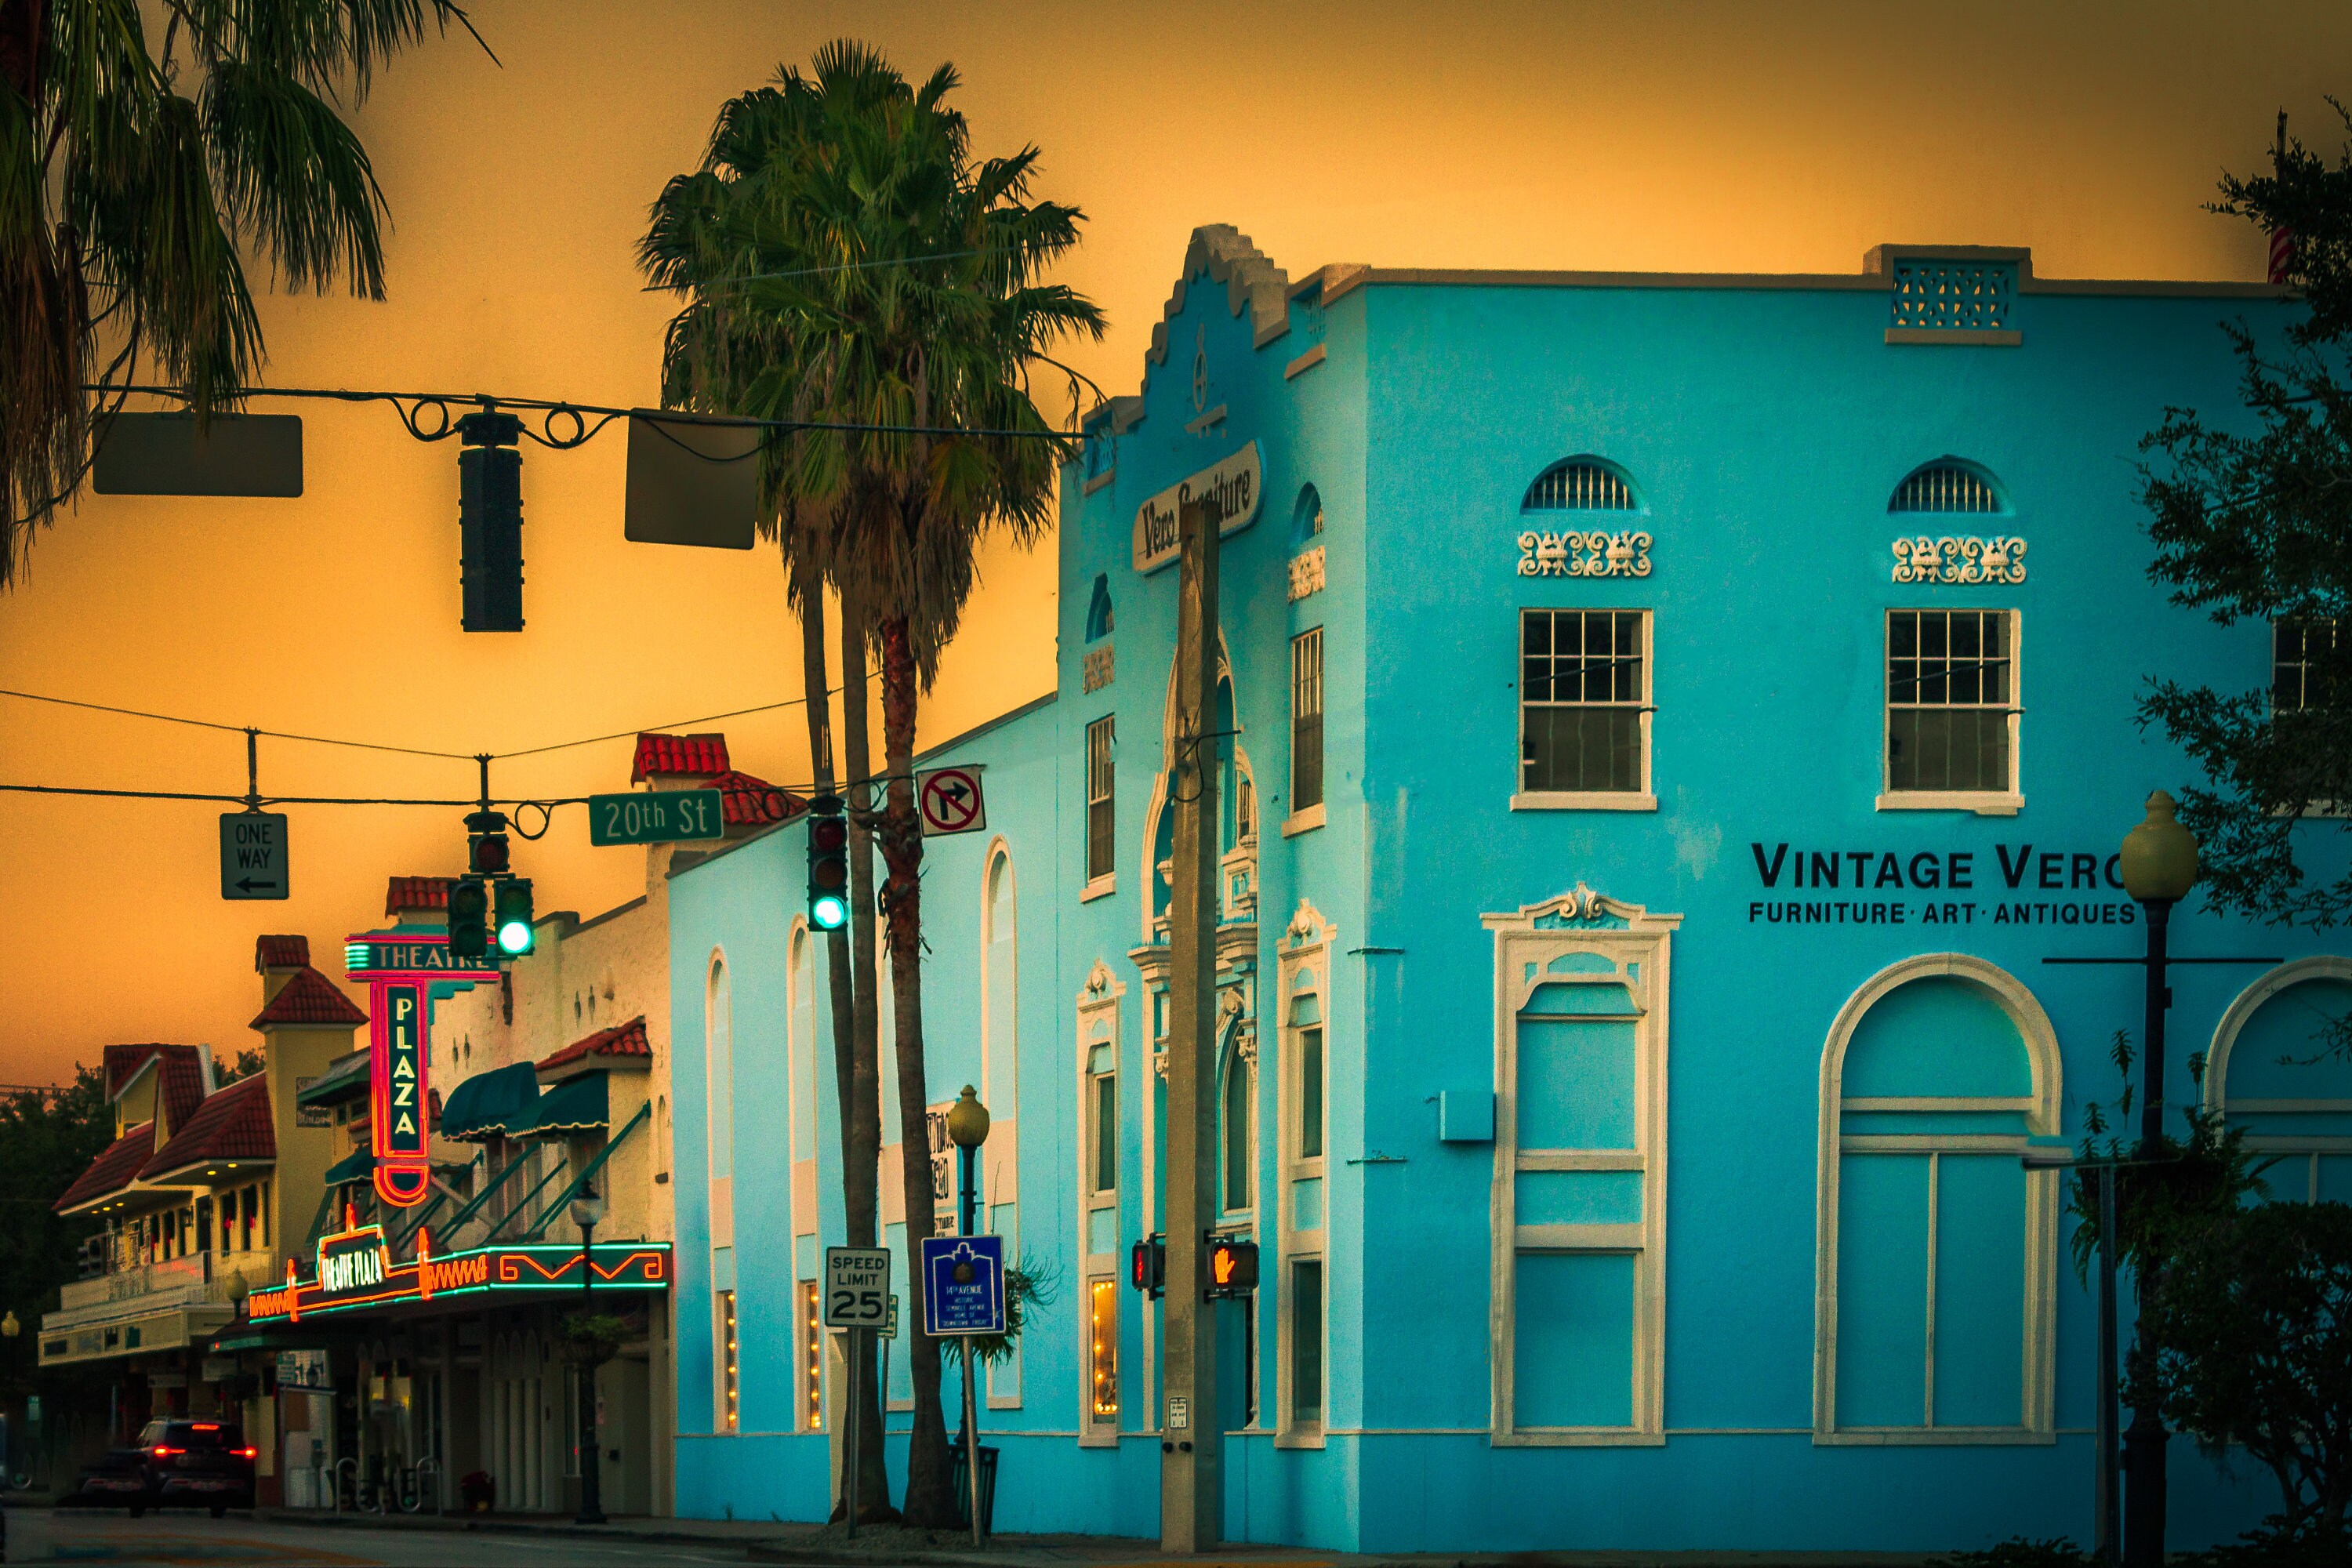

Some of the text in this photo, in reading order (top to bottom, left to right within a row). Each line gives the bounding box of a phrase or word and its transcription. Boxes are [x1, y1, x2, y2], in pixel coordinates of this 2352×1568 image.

[1142, 501, 1174, 559] Vero
[605, 798, 707, 837] 20th St
[236, 823, 272, 844] ONE
[237, 848, 271, 869] WAY
[1751, 842, 1973, 889] VINTAGE
[1749, 902, 2135, 924] FURNITURE ART ANTIQUES
[393, 998, 416, 1134] PLAZA
[322, 1248, 383, 1292] THEATRE PLAZA
[833, 1257, 884, 1269] SPEED
[837, 1273, 878, 1286] LIMIT
[959, 1285, 982, 1294] AVENUE
[831, 1290, 882, 1319] 25
